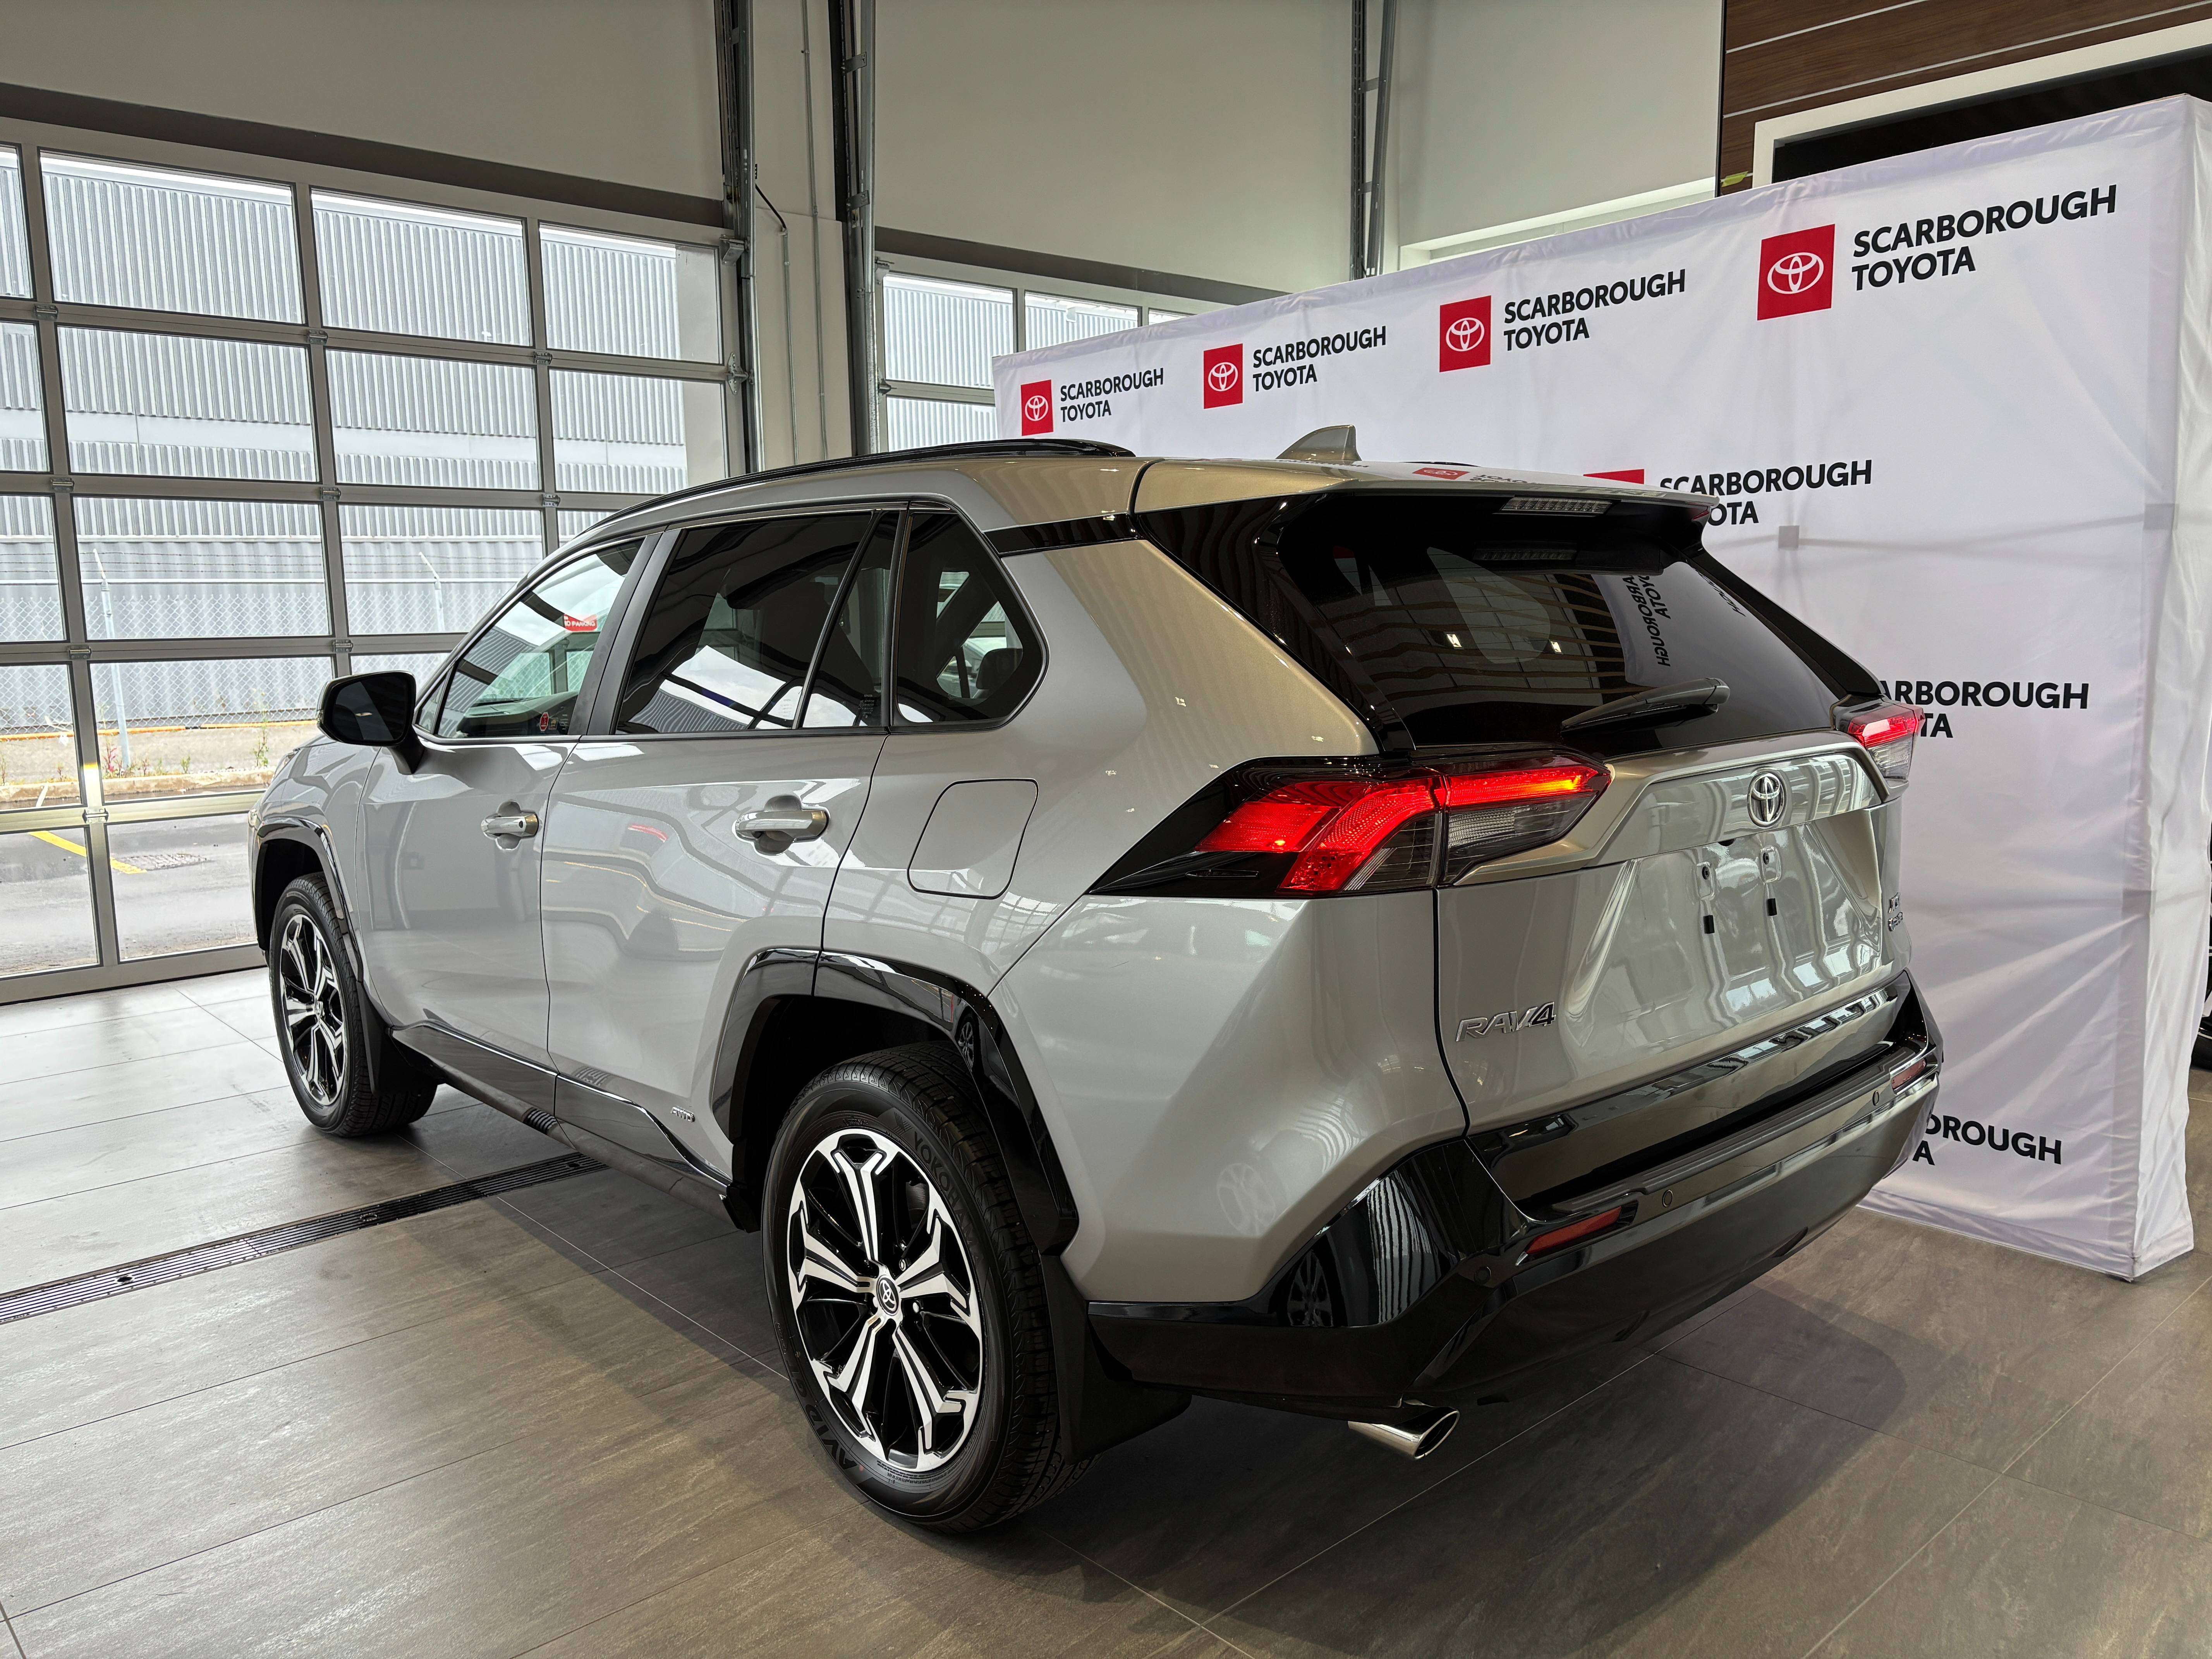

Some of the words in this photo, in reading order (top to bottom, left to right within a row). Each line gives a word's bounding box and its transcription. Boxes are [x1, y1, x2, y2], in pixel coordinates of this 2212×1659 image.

[1853, 184, 2117, 258] SCARBOROUGH
[1851, 246, 1976, 291] TOYOTA
[1504, 268, 1686, 324] SCARBOROUGH
[1253, 325, 1386, 369] SCARBOROUGH
[1503, 317, 1590, 351] TOYOTA
[1060, 367, 1164, 402] SCARBOROUGH
[1252, 363, 1318, 392] TOYOTA
[1060, 399, 1112, 422] TOYOTA
[1707, 501, 1759, 526] OTA
[1879, 680, 2089, 709] RBOROUGH
[1455, 1001, 1556, 1042] RAV4
[670, 1106, 695, 1122] AWD
[1925, 1114, 2062, 1165] OROUGH
[806, 1404, 858, 1470] AVID
